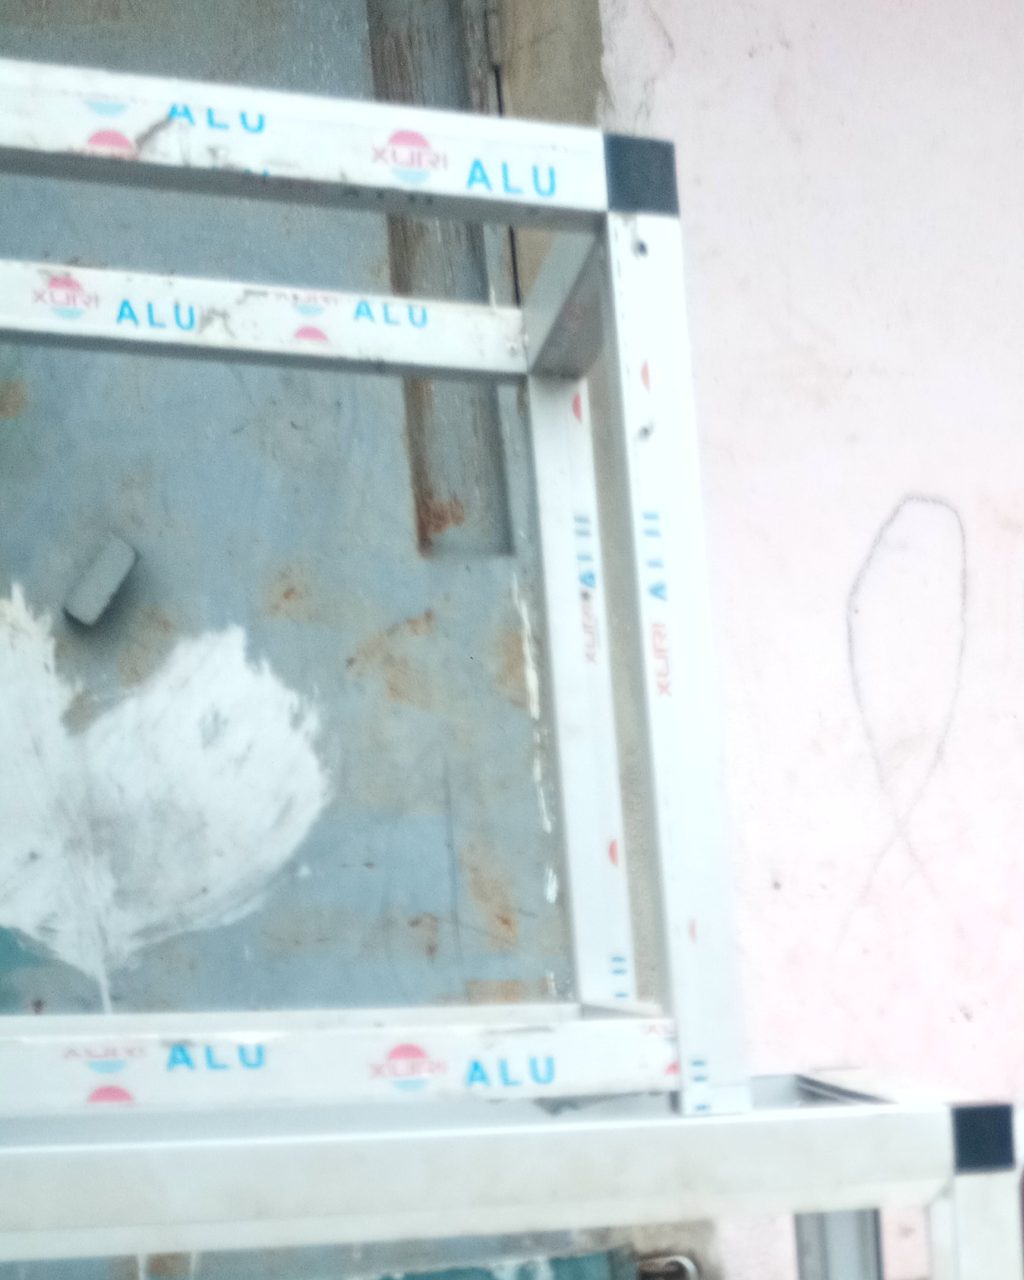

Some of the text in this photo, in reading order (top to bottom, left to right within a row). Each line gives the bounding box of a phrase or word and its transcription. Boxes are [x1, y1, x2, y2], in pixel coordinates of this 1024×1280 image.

[168, 103, 266, 133] ALU
[466, 158, 556, 197] ALU
[116, 298, 196, 331] ALU
[354, 299, 428, 328] ALU
[166, 1042, 266, 1071] ALU
[466, 1055, 557, 1087] ALU
